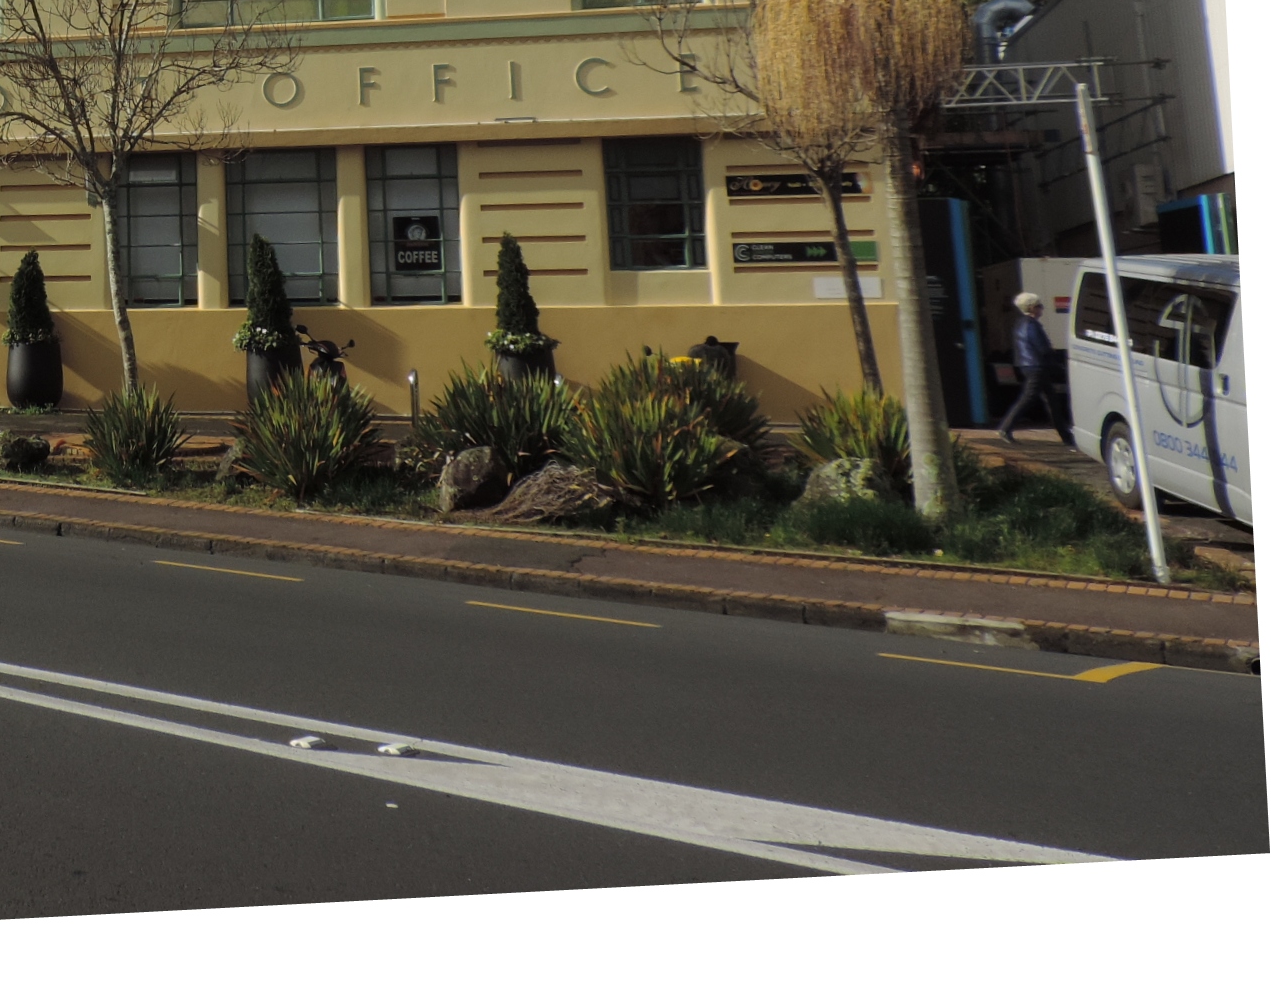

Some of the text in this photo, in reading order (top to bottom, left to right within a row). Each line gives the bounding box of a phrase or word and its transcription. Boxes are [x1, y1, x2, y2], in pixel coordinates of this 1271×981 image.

[261, 53, 699, 107] OFFICE
[397, 250, 439, 264] COFFEE
[1153, 429, 1183, 454] 0800
